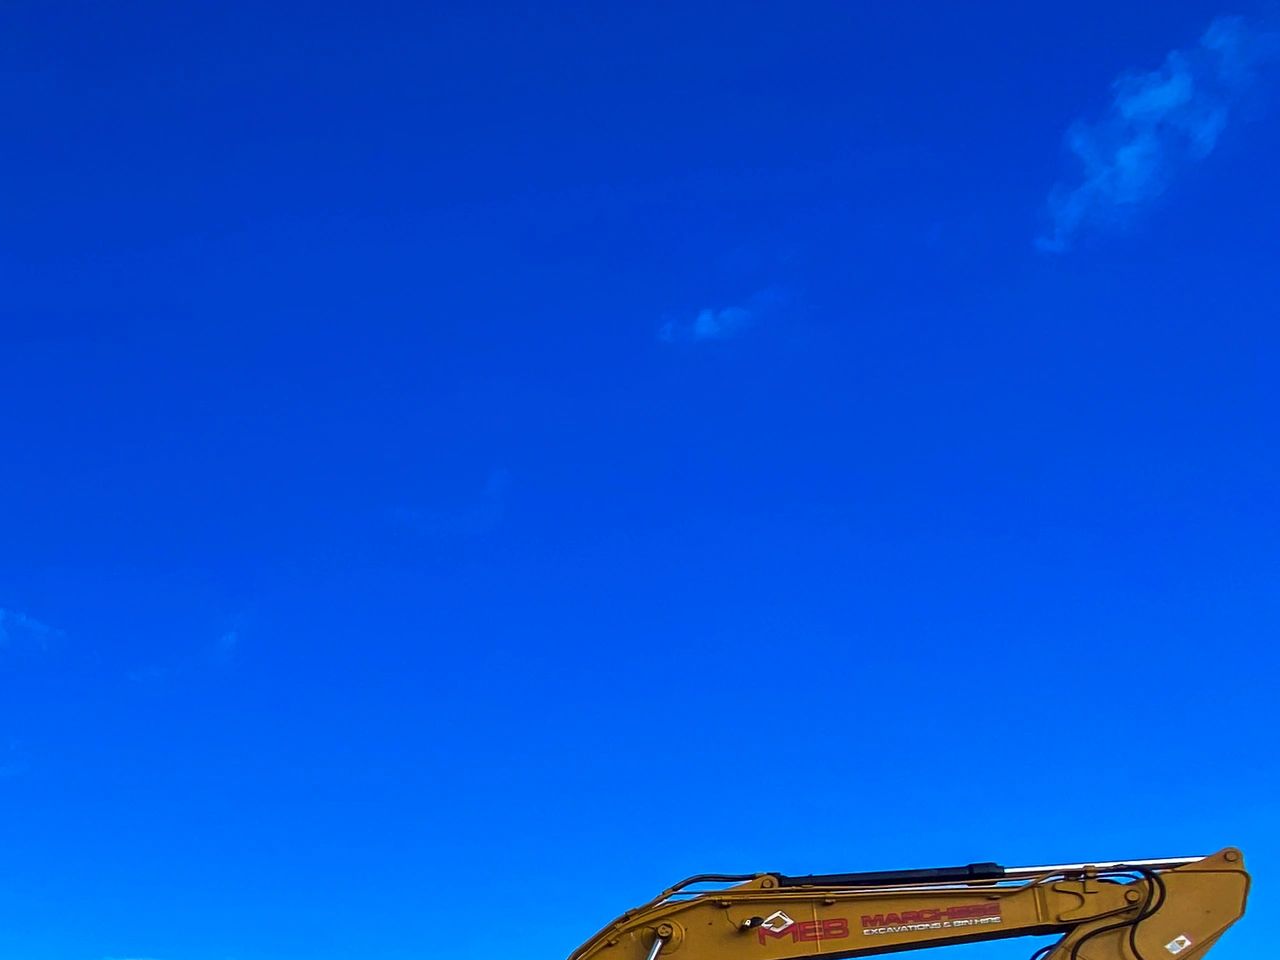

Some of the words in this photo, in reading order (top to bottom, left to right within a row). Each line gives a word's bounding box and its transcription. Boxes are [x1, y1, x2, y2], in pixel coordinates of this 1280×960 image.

[861, 902, 1001, 928] MARCHESE
[863, 922, 941, 936] EXCAVATIONS
[953, 918, 972, 927] BIN
[974, 916, 1001, 925] HIRE
[757, 918, 849, 946] MEB
